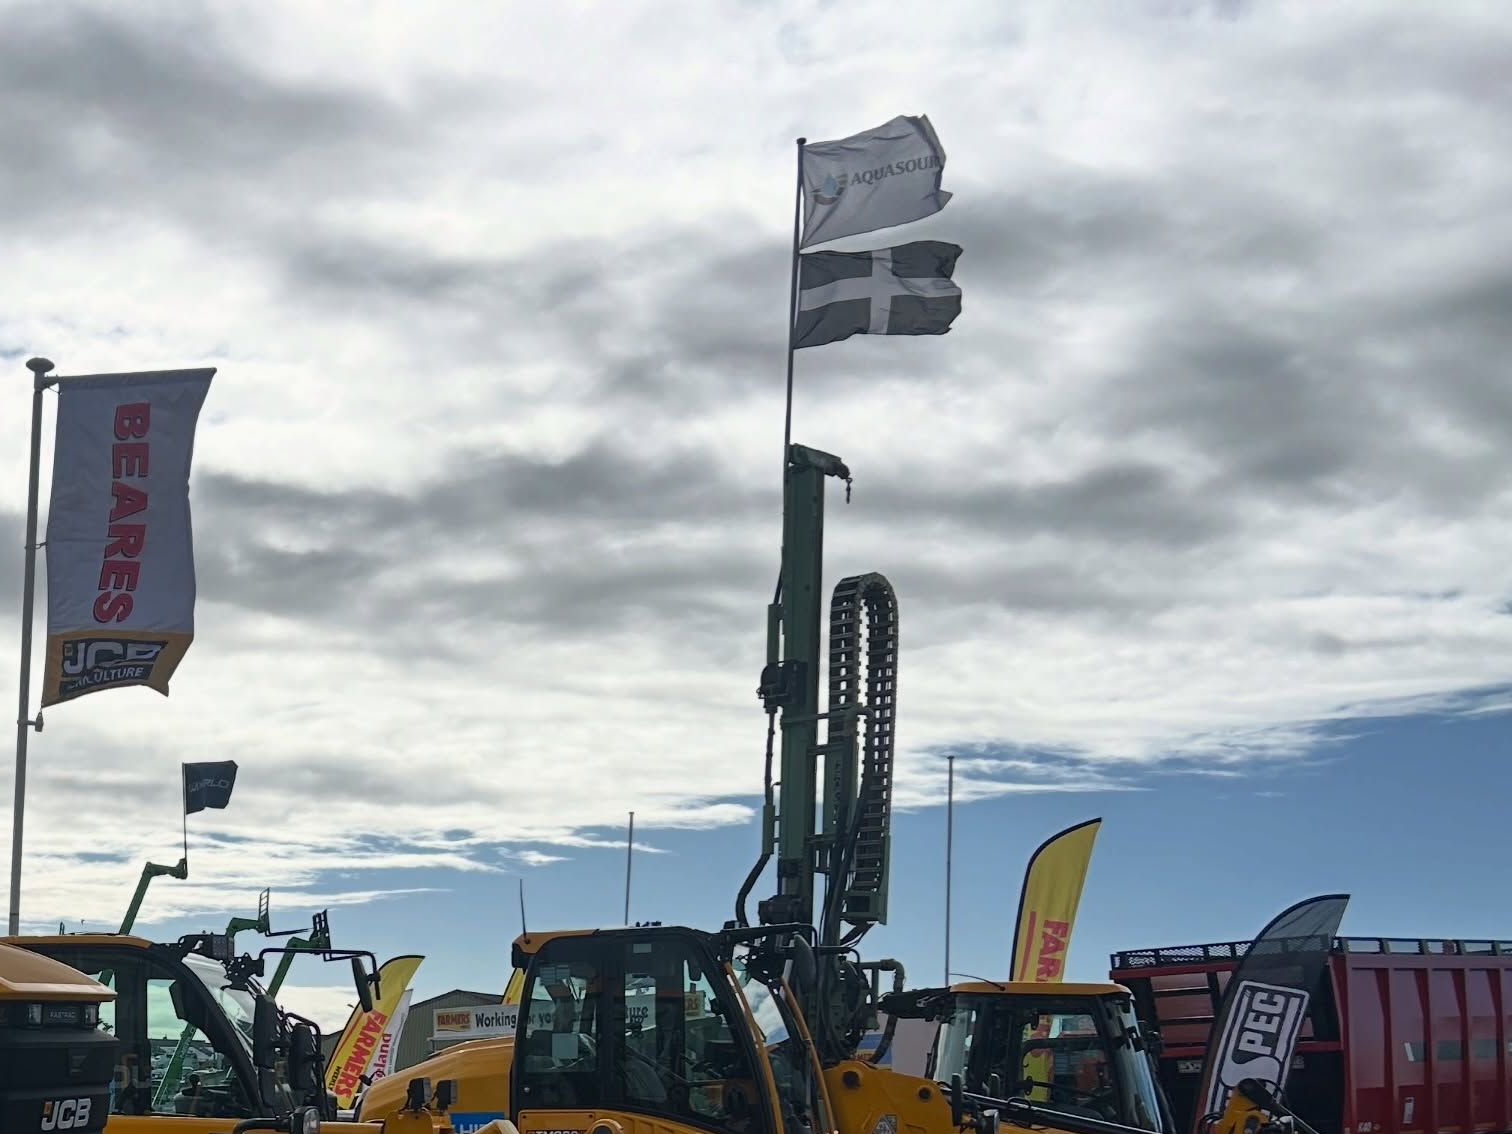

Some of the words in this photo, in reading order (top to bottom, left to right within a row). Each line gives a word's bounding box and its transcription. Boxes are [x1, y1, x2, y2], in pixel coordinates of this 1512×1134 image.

[92, 401, 152, 624] BEARES
[437, 1012, 470, 1026] FARMERS
[475, 1011, 517, 1029] Working
[335, 1008, 388, 1098] FARMERS
[40, 1097, 92, 1132] JCB
